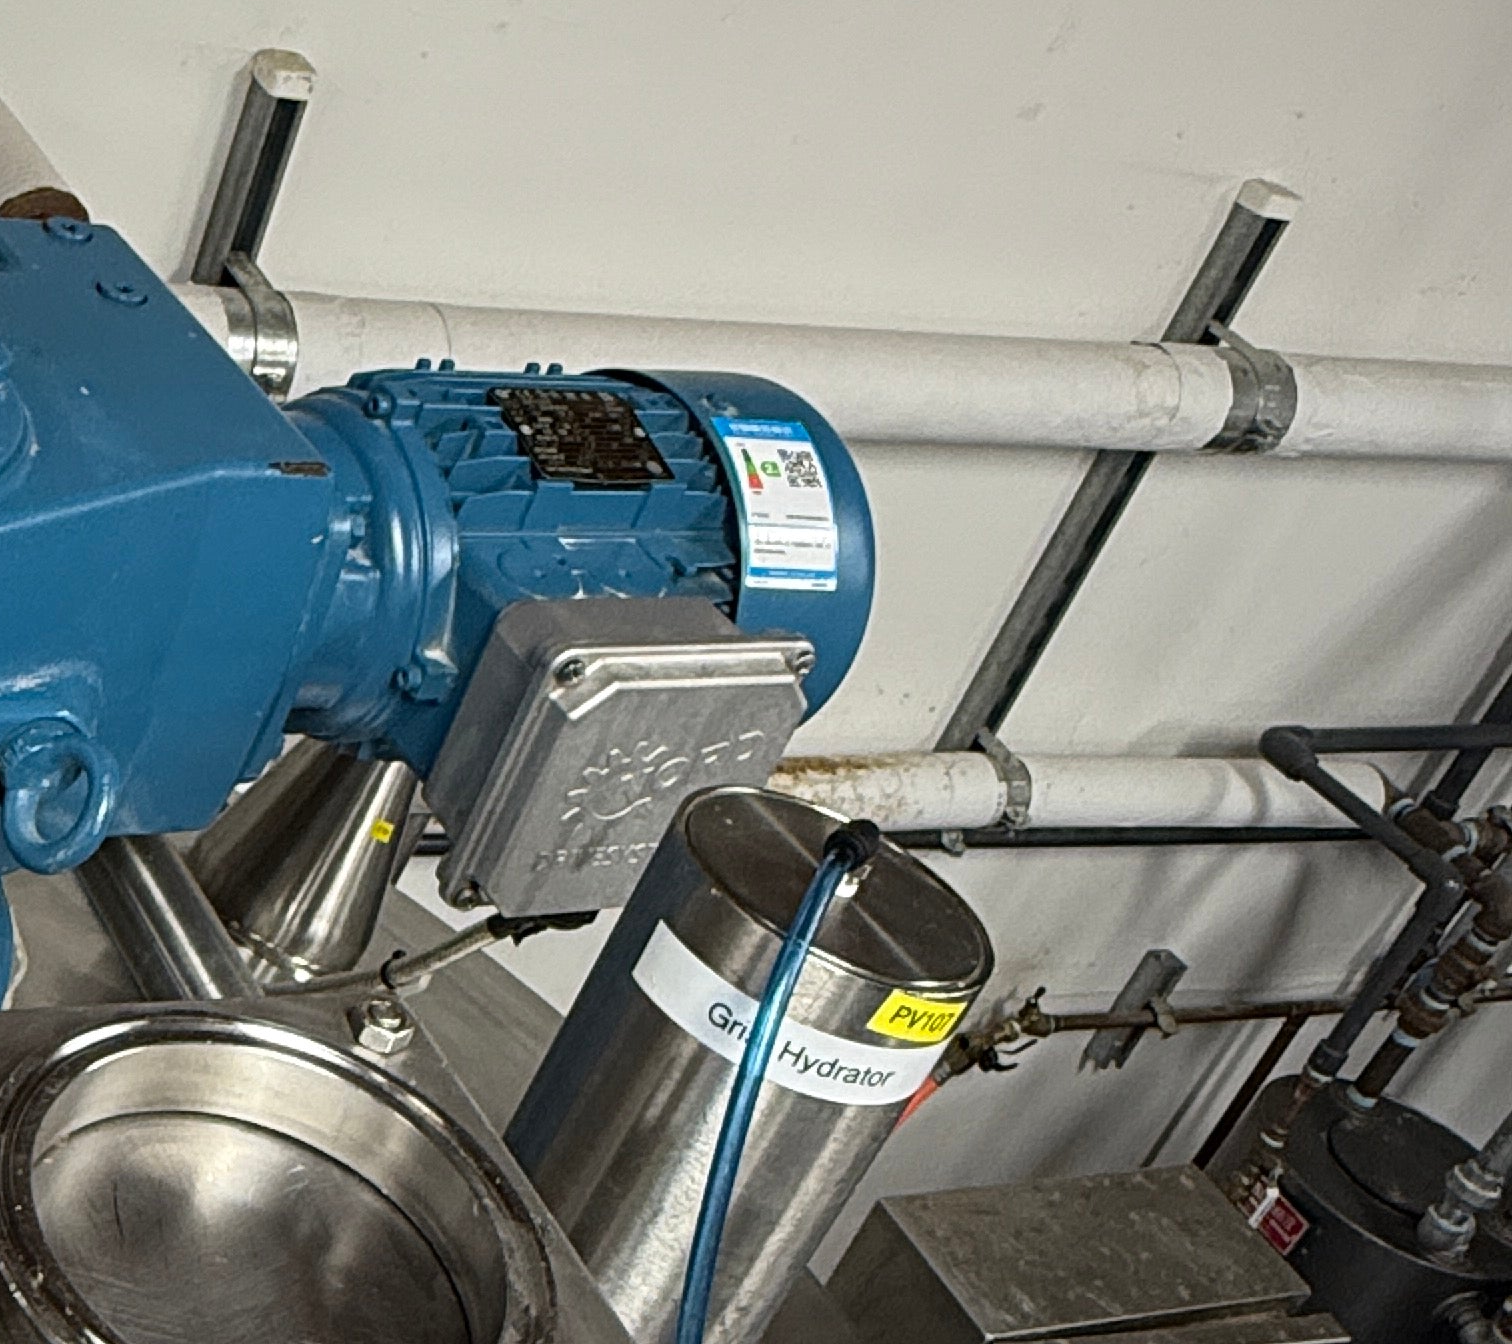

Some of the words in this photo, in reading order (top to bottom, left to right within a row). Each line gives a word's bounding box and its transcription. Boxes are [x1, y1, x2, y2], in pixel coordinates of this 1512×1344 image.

[708, 1001, 750, 1044] Gri
[778, 1040, 896, 1088] Hydrator
[888, 1004, 956, 1033] PV107
